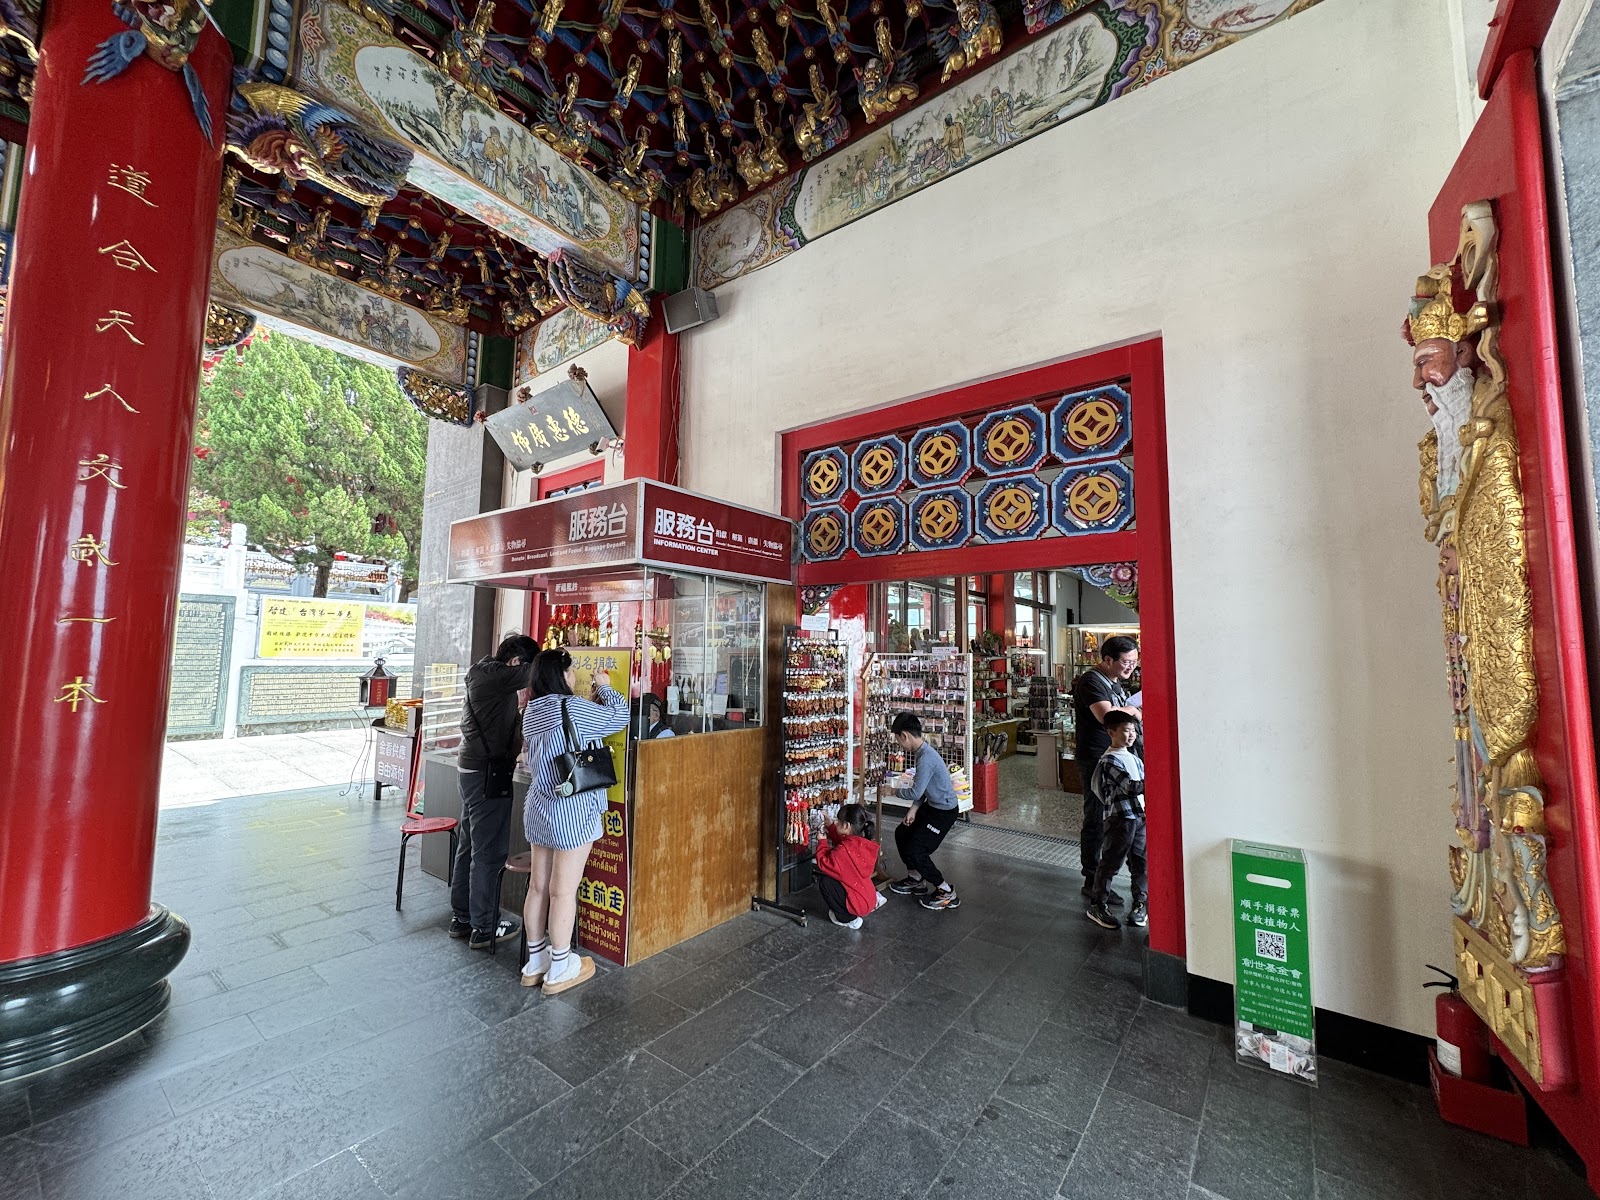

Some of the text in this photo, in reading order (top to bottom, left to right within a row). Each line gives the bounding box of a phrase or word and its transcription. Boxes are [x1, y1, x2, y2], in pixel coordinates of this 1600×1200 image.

[568, 502, 628, 542] 服務台
[654, 507, 714, 545] 服務台
[653, 538, 719, 556] INFORMATION CENTER
[578, 880, 623, 912] 往前走
[1240, 899, 1300, 919] 順手捐發票
[1240, 912, 1301, 932] 救救植物人
[1242, 957, 1303, 980] 創世基金會
